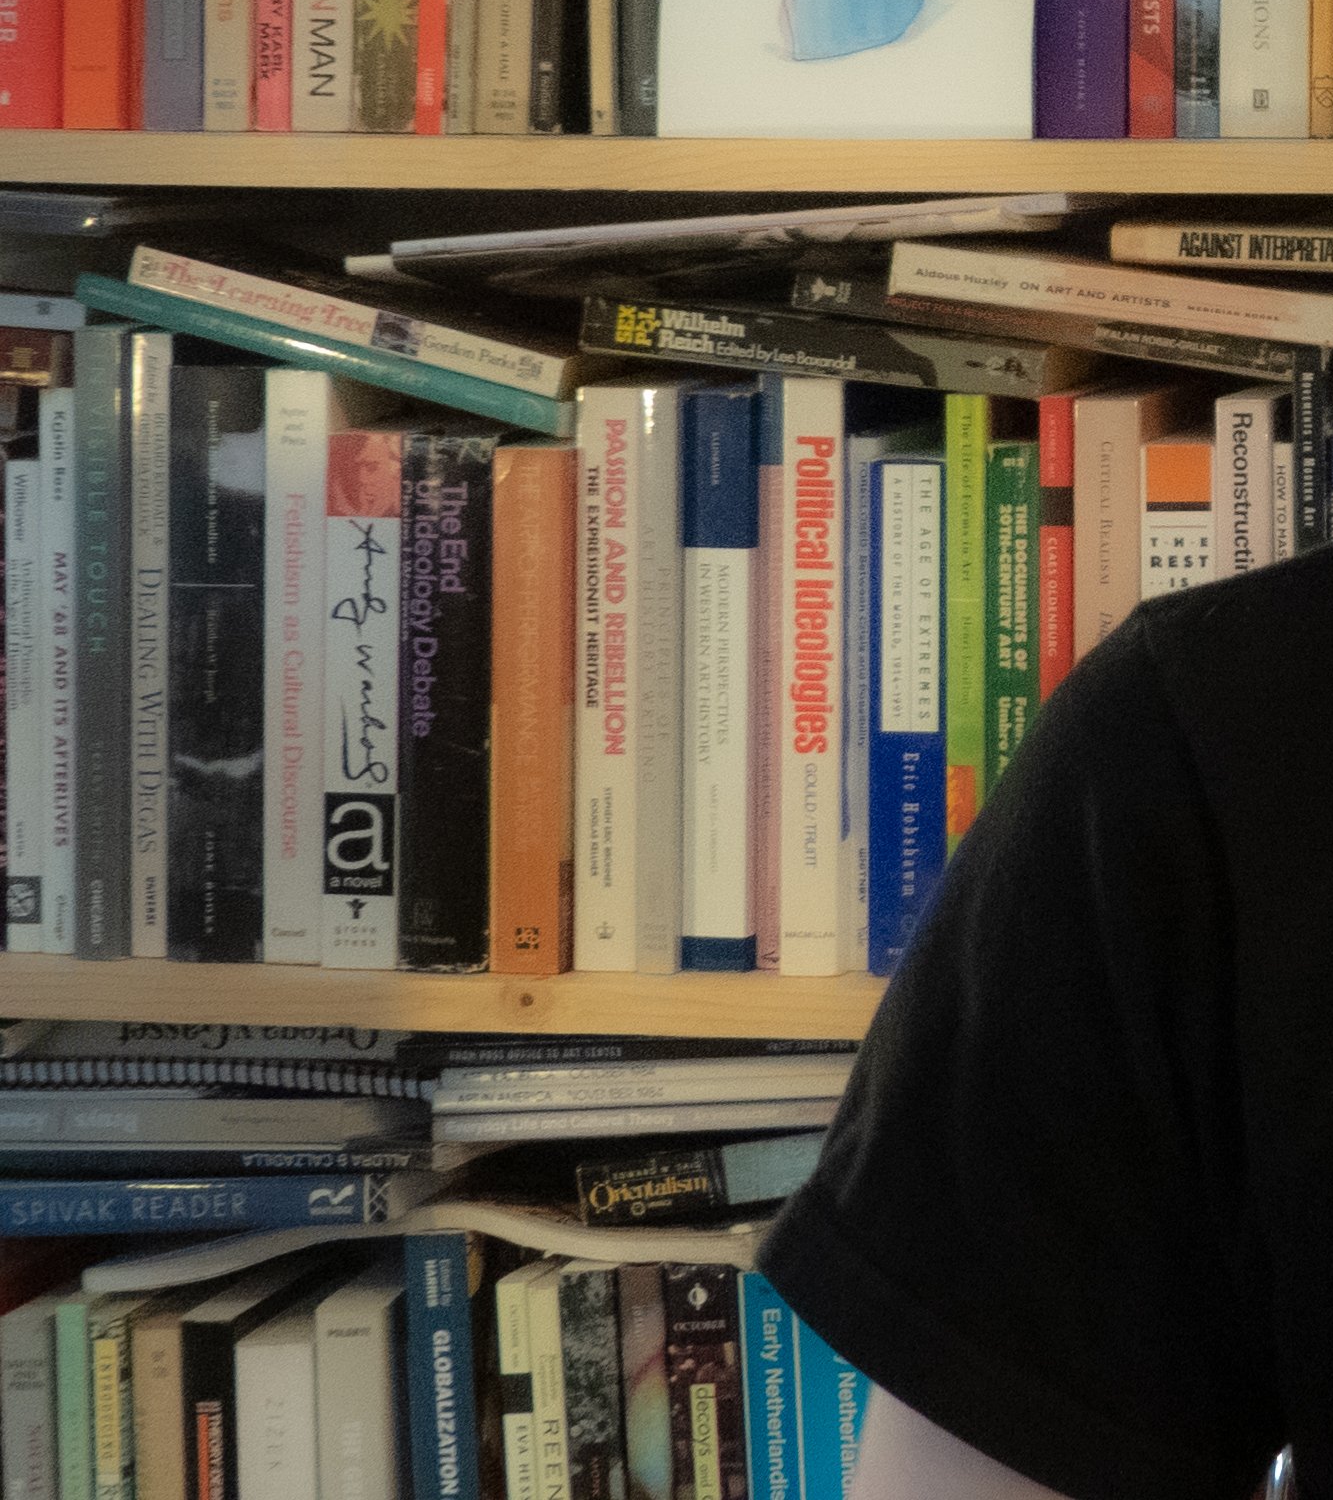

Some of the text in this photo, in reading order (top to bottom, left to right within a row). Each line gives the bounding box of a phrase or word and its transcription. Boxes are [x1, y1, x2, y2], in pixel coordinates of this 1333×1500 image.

[309, 18, 335, 98] MAN
[1181, 232, 1243, 258] AGAINST
[790, 436, 835, 755] Political Ideologies
[11, 1192, 247, 1225] SPIVAK READER
[589, 1175, 708, 1212] Orientalism
[759, 1308, 784, 1364] Early
[432, 1330, 458, 1493] GLOBALIZATION
[693, 1387, 719, 1458] decoys
